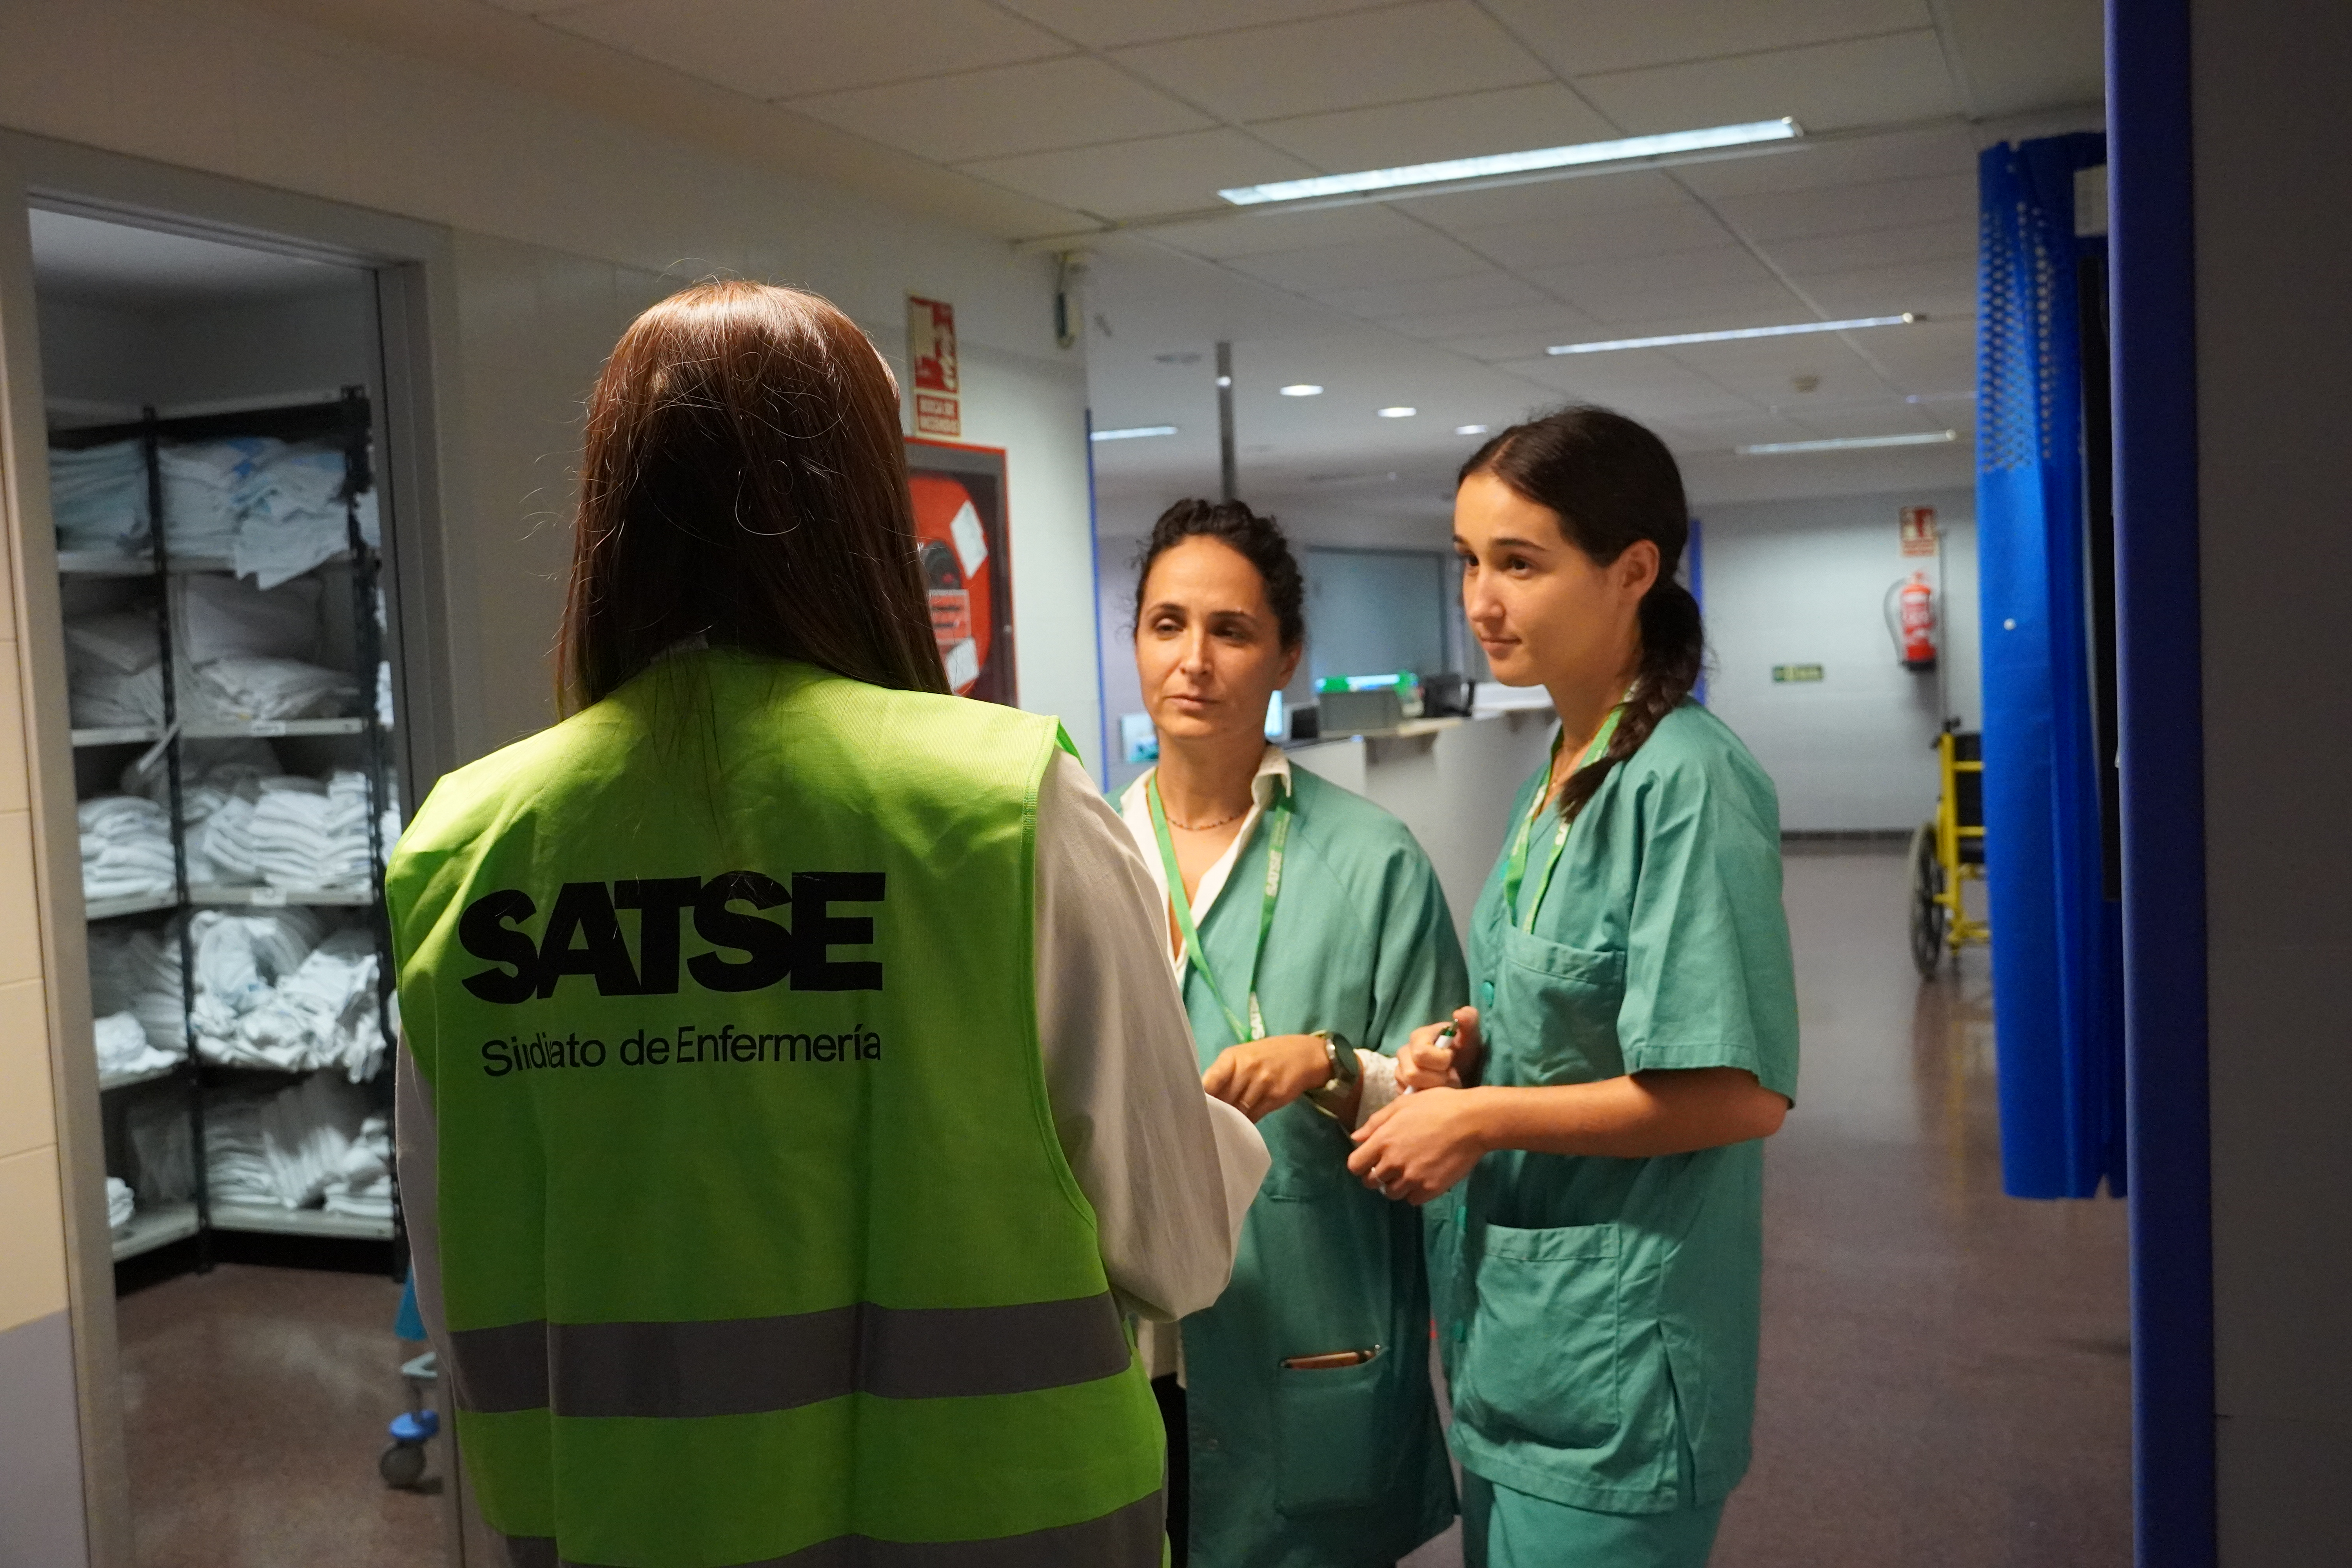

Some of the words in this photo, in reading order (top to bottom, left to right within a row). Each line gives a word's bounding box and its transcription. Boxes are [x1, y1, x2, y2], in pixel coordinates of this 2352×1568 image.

[459, 871, 886, 1004] SATSE
[620, 1029, 670, 1066] de
[677, 1024, 880, 1063] Enfermería
